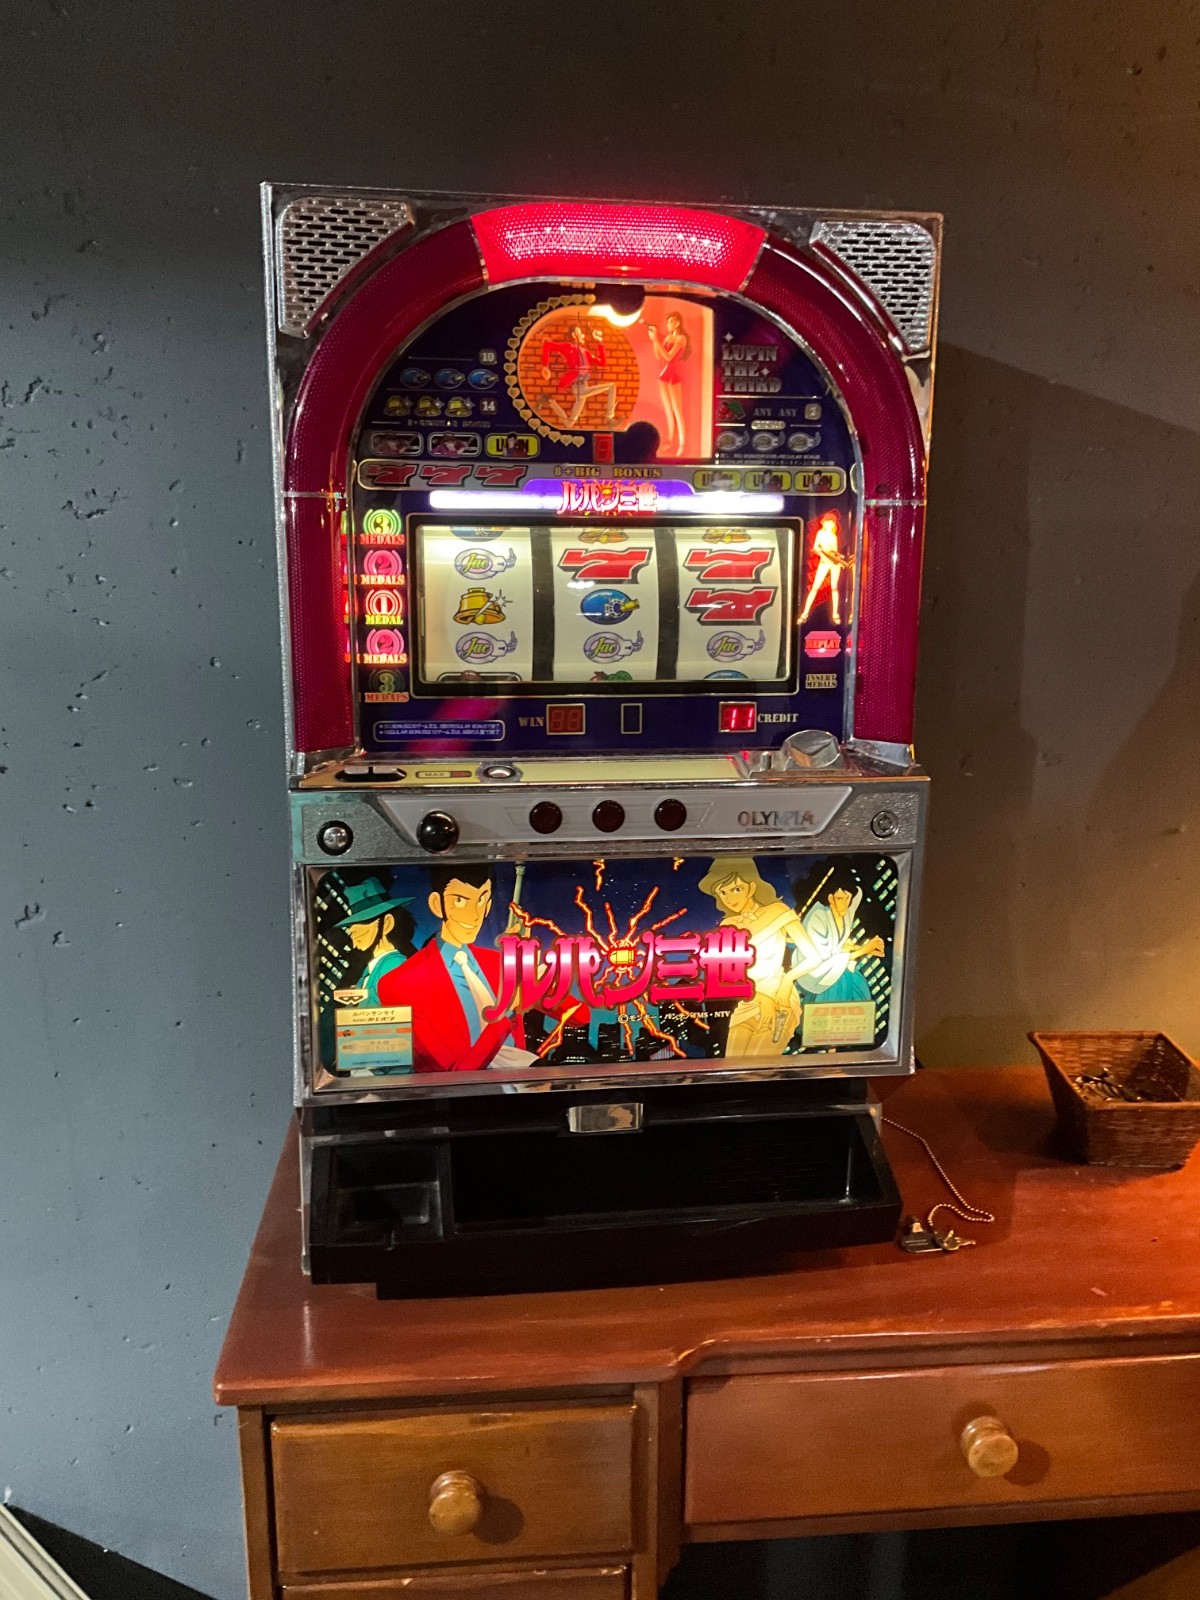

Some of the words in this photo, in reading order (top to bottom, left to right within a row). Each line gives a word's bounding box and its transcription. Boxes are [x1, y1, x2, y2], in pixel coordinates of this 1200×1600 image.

[481, 352, 496, 363] 10
[722, 344, 779, 361] LUPIN
[722, 361, 759, 377] THE
[722, 377, 781, 393] THIRD
[481, 401, 496, 412] 14
[753, 408, 773, 417] ANY
[779, 408, 798, 417] ANY
[613, 467, 662, 478] BONUS
[360, 534, 405, 545] MEDALS
[462, 553, 490, 575] Jac
[361, 574, 405, 586] MEDALS
[365, 615, 404, 625] MEDAL
[463, 636, 490, 659] Jac
[588, 637, 617, 659] Jac
[714, 636, 741, 656] Jac
[806, 639, 840, 649] REPLAY
[363, 653, 408, 664] MEDALS
[806, 673, 837, 682] INSERT
[806, 681, 837, 689] MEDALS
[365, 692, 409, 703] MEDALS
[518, 716, 544, 727] WIN
[757, 713, 799, 723] CREDIT
[482, 926, 755, 1023] ルパン三世
